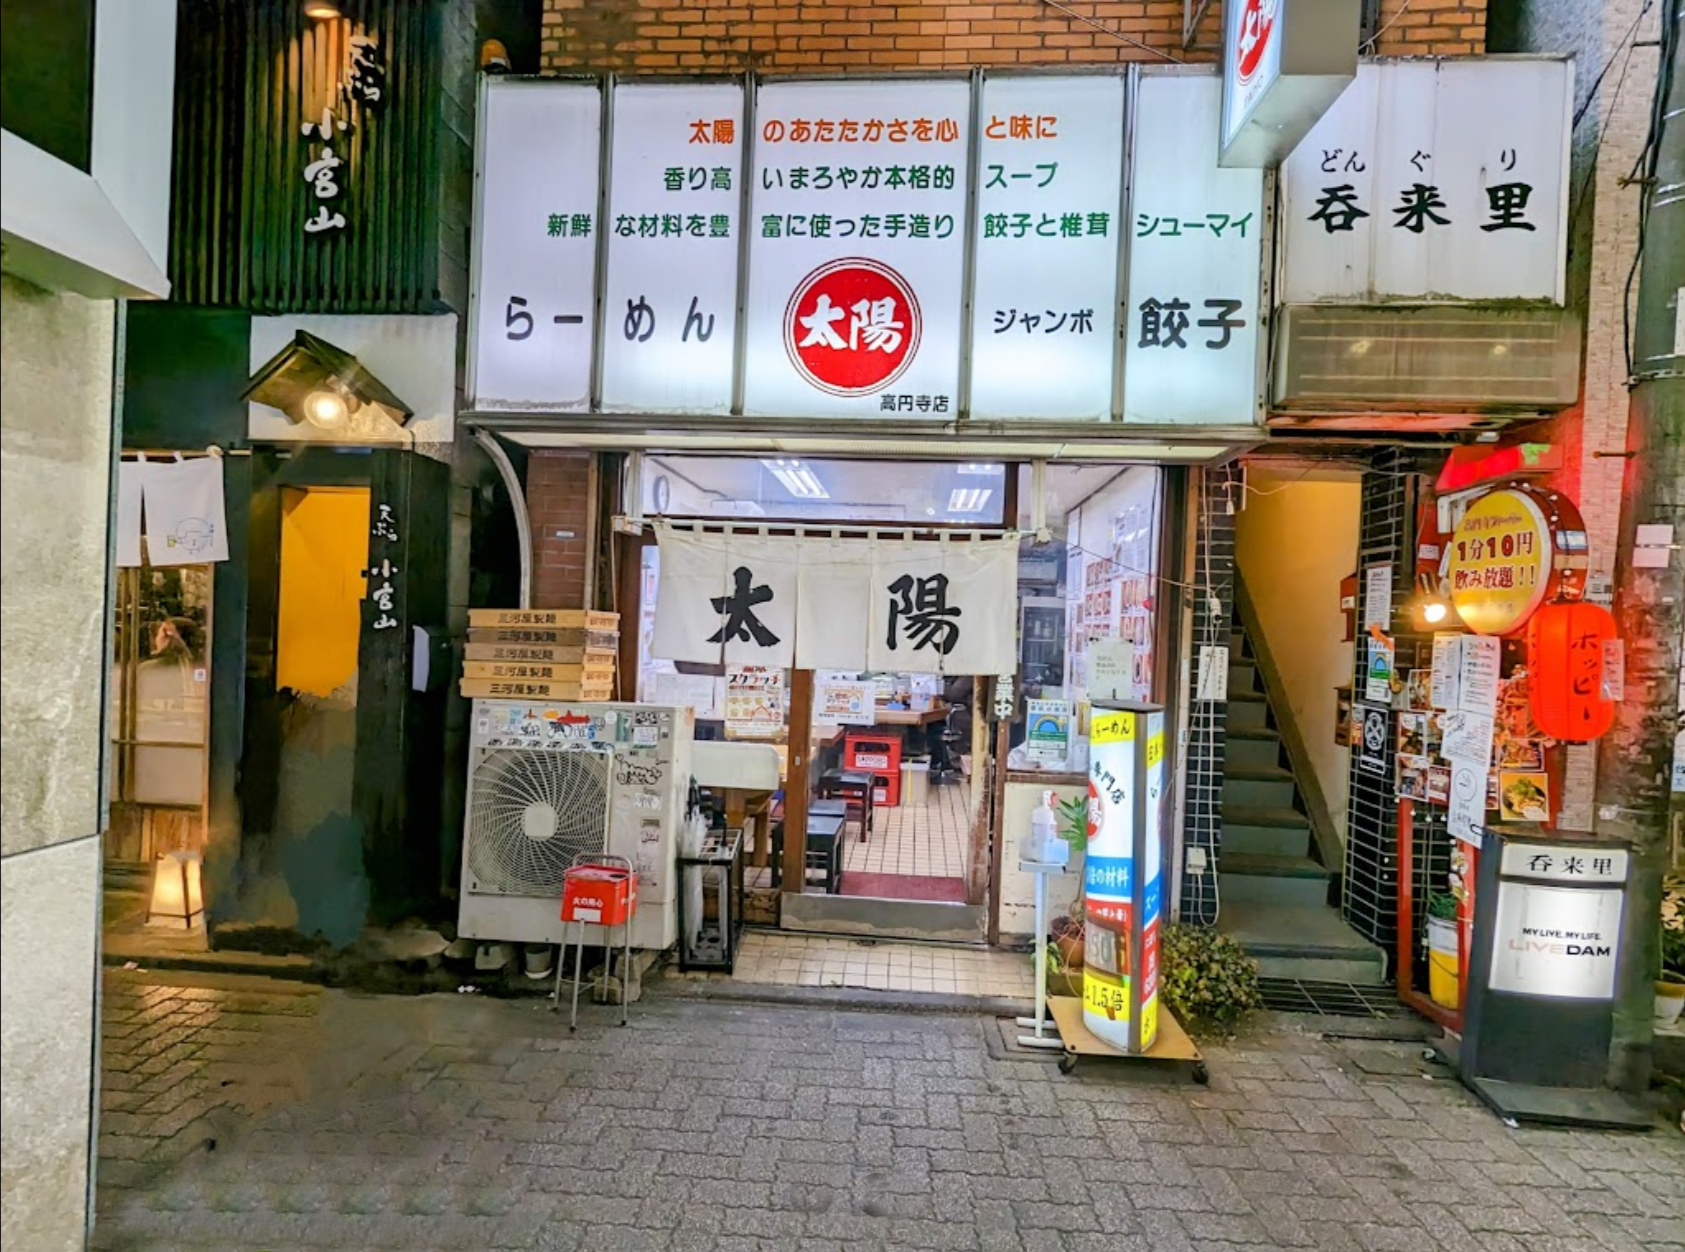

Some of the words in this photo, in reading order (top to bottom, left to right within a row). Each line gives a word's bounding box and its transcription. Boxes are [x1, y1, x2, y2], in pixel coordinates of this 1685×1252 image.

[301, 106, 355, 235] 小宮山
[506, 296, 715, 342] らーめん
[798, 294, 905, 354] 太陽
[993, 309, 1094, 335] ジャンボ
[1138, 297, 1246, 350] 餃子
[880, 394, 949, 414] 高円寺店
[1456, 531, 1534, 561] 1分10円
[706, 566, 963, 655] 太陽
[1571, 629, 1599, 721] ホッピー
